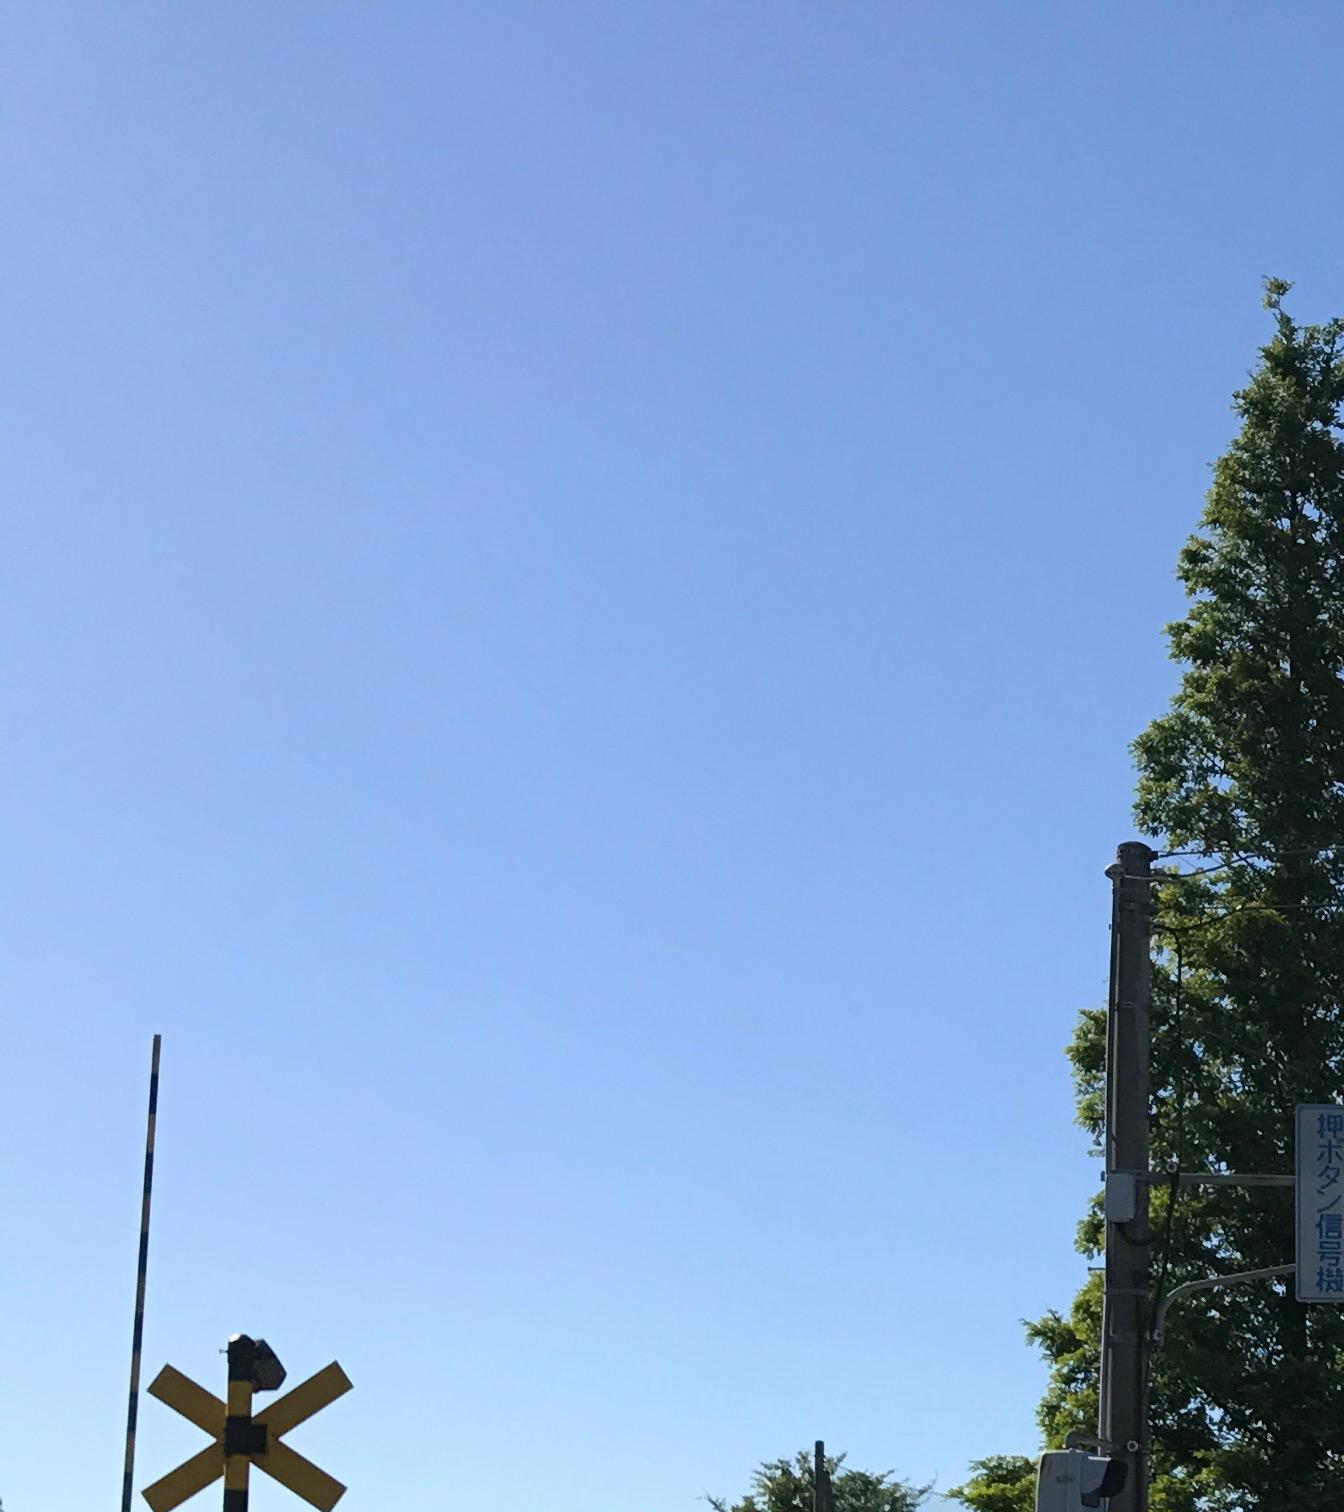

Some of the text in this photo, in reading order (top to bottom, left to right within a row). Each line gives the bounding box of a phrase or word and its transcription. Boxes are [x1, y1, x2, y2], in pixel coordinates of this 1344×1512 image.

[1315, 1113, 1344, 1293] 押ボタン信号機
